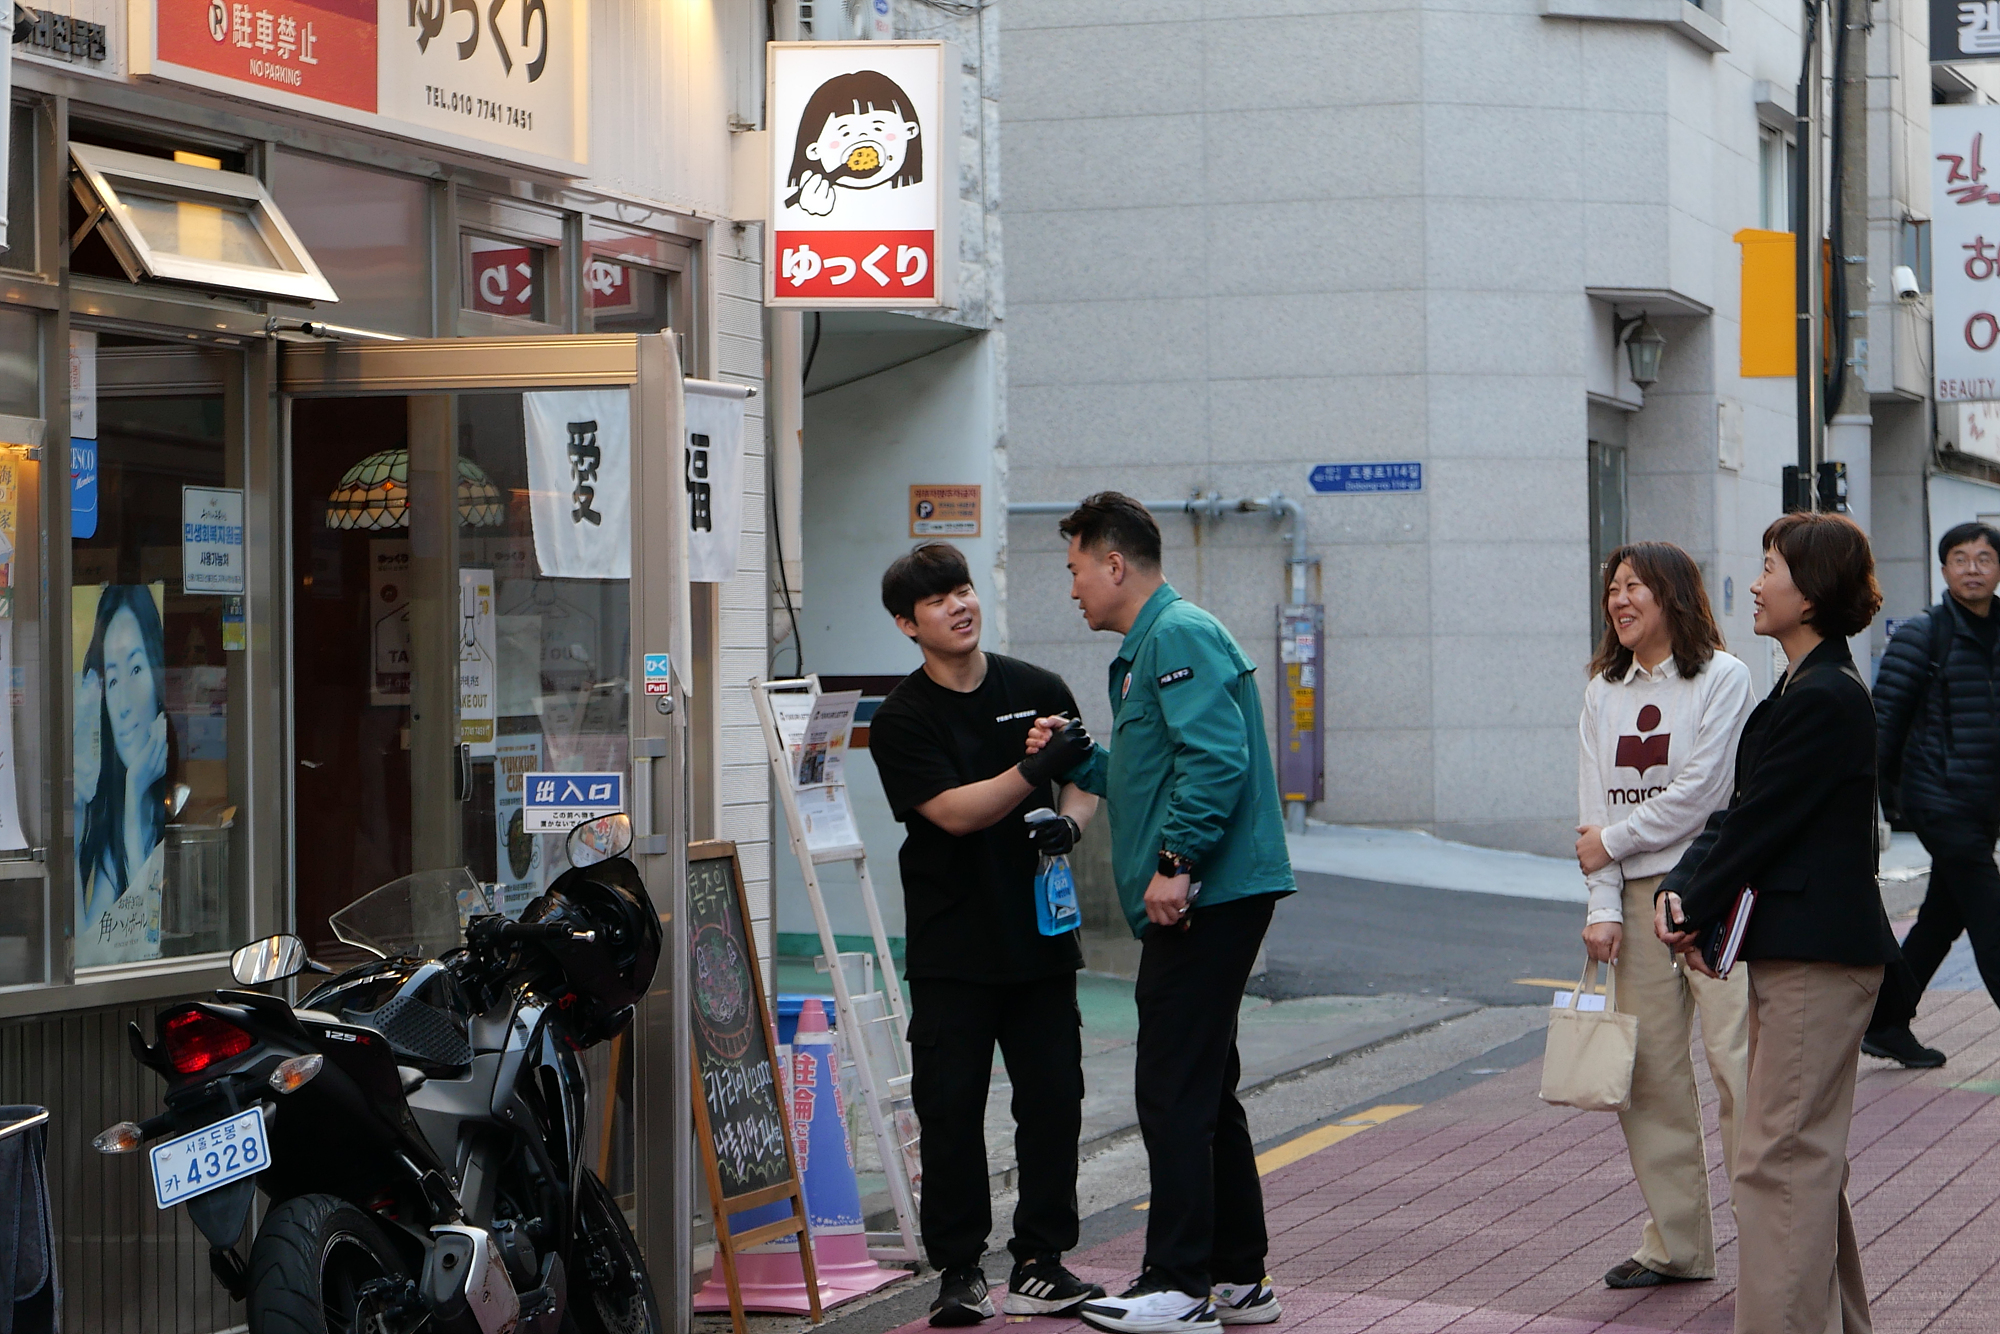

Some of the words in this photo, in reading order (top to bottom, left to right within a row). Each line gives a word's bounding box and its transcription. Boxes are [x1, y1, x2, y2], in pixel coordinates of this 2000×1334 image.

[232, 3, 318, 65] 駐車禁止
[250, 59, 264, 77] NO
[265, 63, 302, 86] PARKING
[477, 98, 502, 123] 7741
[507, 107, 532, 131] 7451
[782, 244, 928, 287] ゆっくり
[1940, 378, 1995, 399] BEAUTY
[185, 523, 242, 546] 민생회복지원금
[200, 551, 229, 567] 사용가능처
[647, 660, 666, 672] ひく
[648, 684, 666, 692] Pull
[473, 694, 487, 708] OUT
[501, 755, 537, 774] YUKKURI
[535, 780, 612, 803] 出入口
[185, 1137, 207, 1154] 서울
[211, 1124, 236, 1146] 도봉
[165, 1174, 180, 1193] 카
[187, 1137, 258, 1184] 4328
